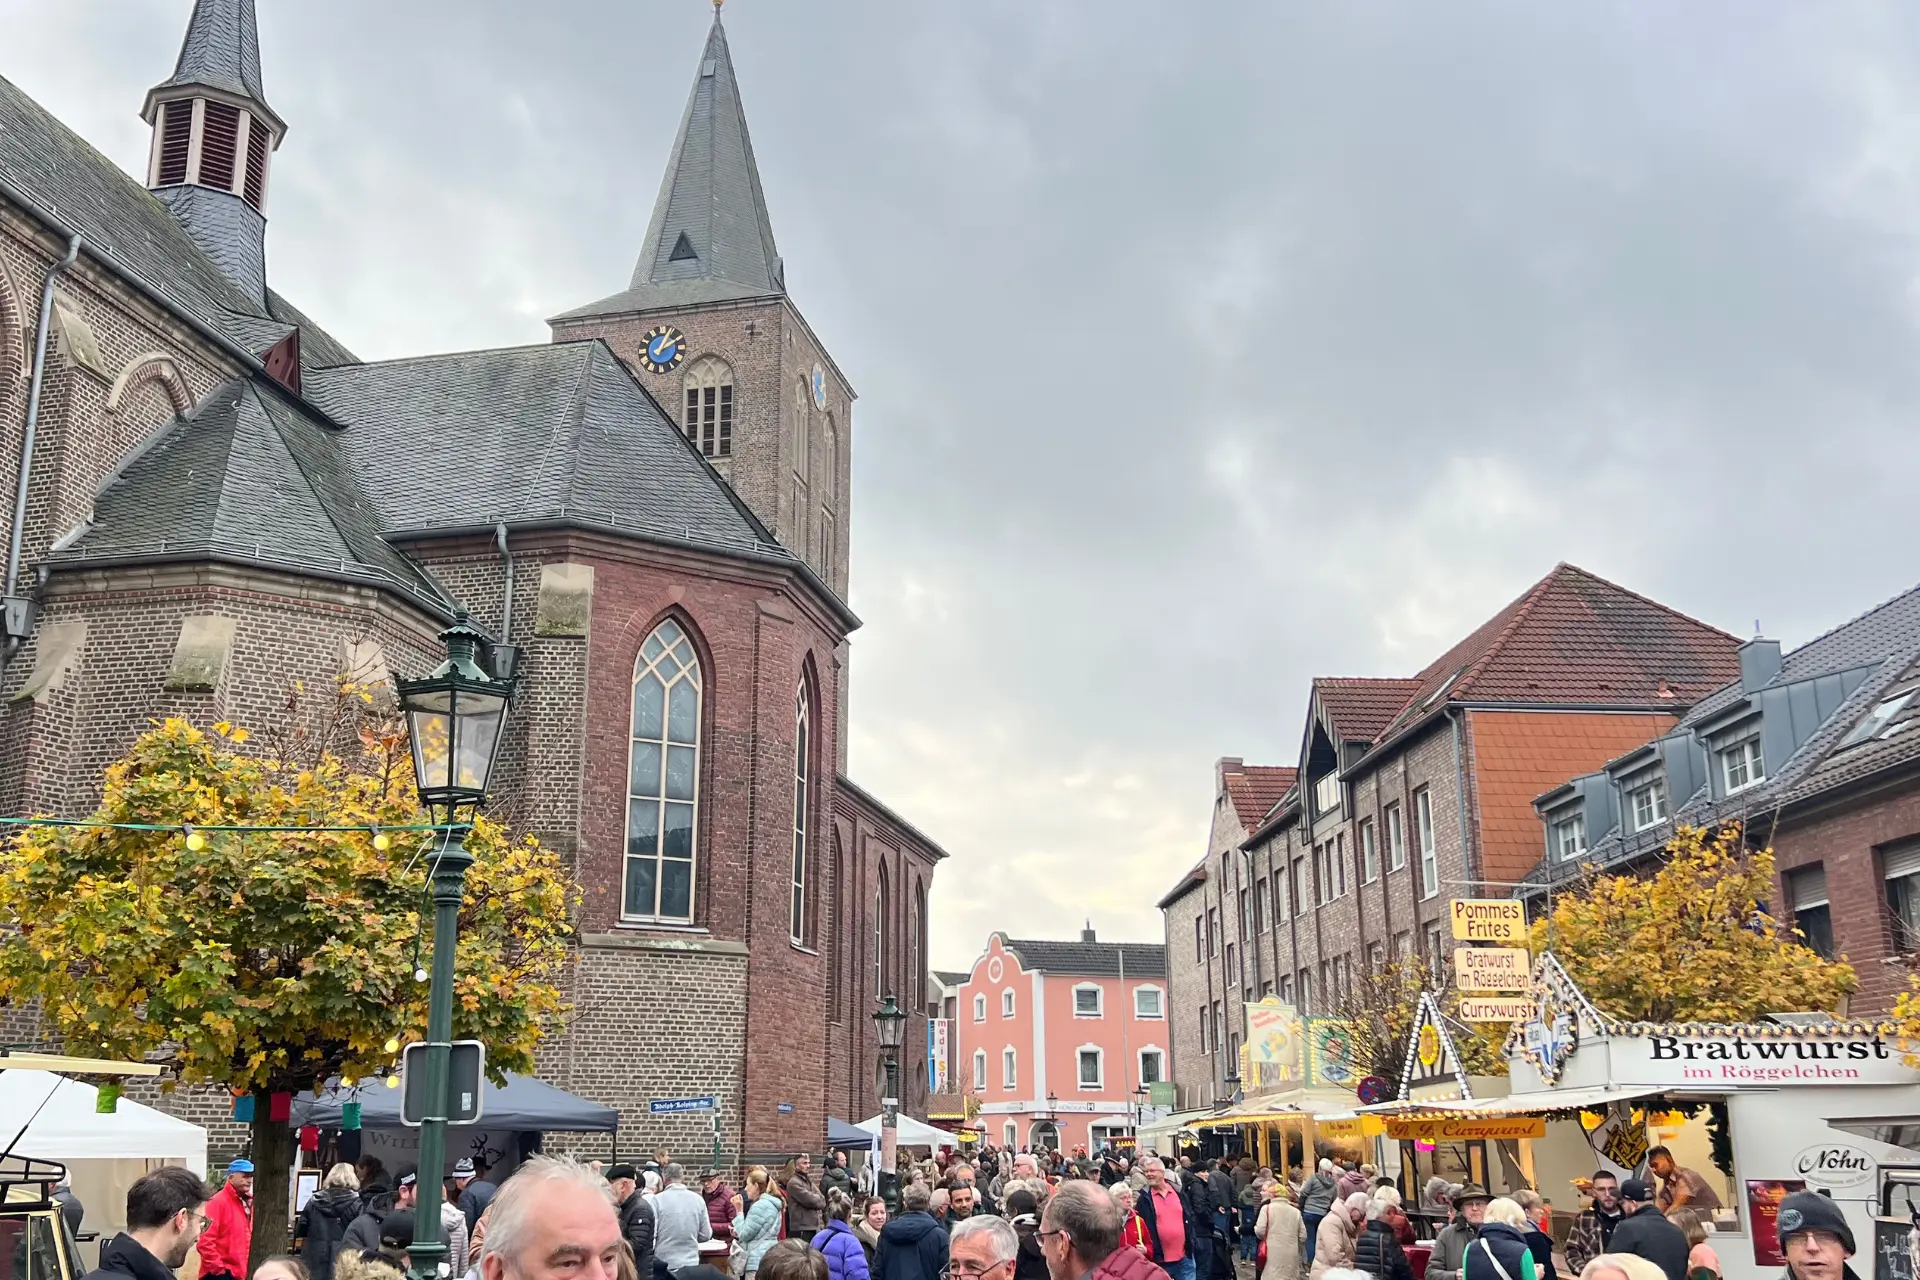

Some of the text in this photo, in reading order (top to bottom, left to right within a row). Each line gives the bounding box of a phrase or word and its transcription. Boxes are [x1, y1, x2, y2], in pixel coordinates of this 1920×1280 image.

[1455, 902, 1519, 919] Pommes
[1468, 920, 1511, 937] Frites
[1466, 951, 1515, 968] Bratwurst
[1458, 970, 1529, 988] im Röggelchen
[1461, 1001, 1532, 1019] Currywurst
[1649, 1036, 1889, 1060] Bratwurst
[1683, 1064, 1860, 1080] im Röggelchen
[1442, 1122, 1536, 1139] Currywurst
[1798, 1149, 1872, 1174] Nohn
